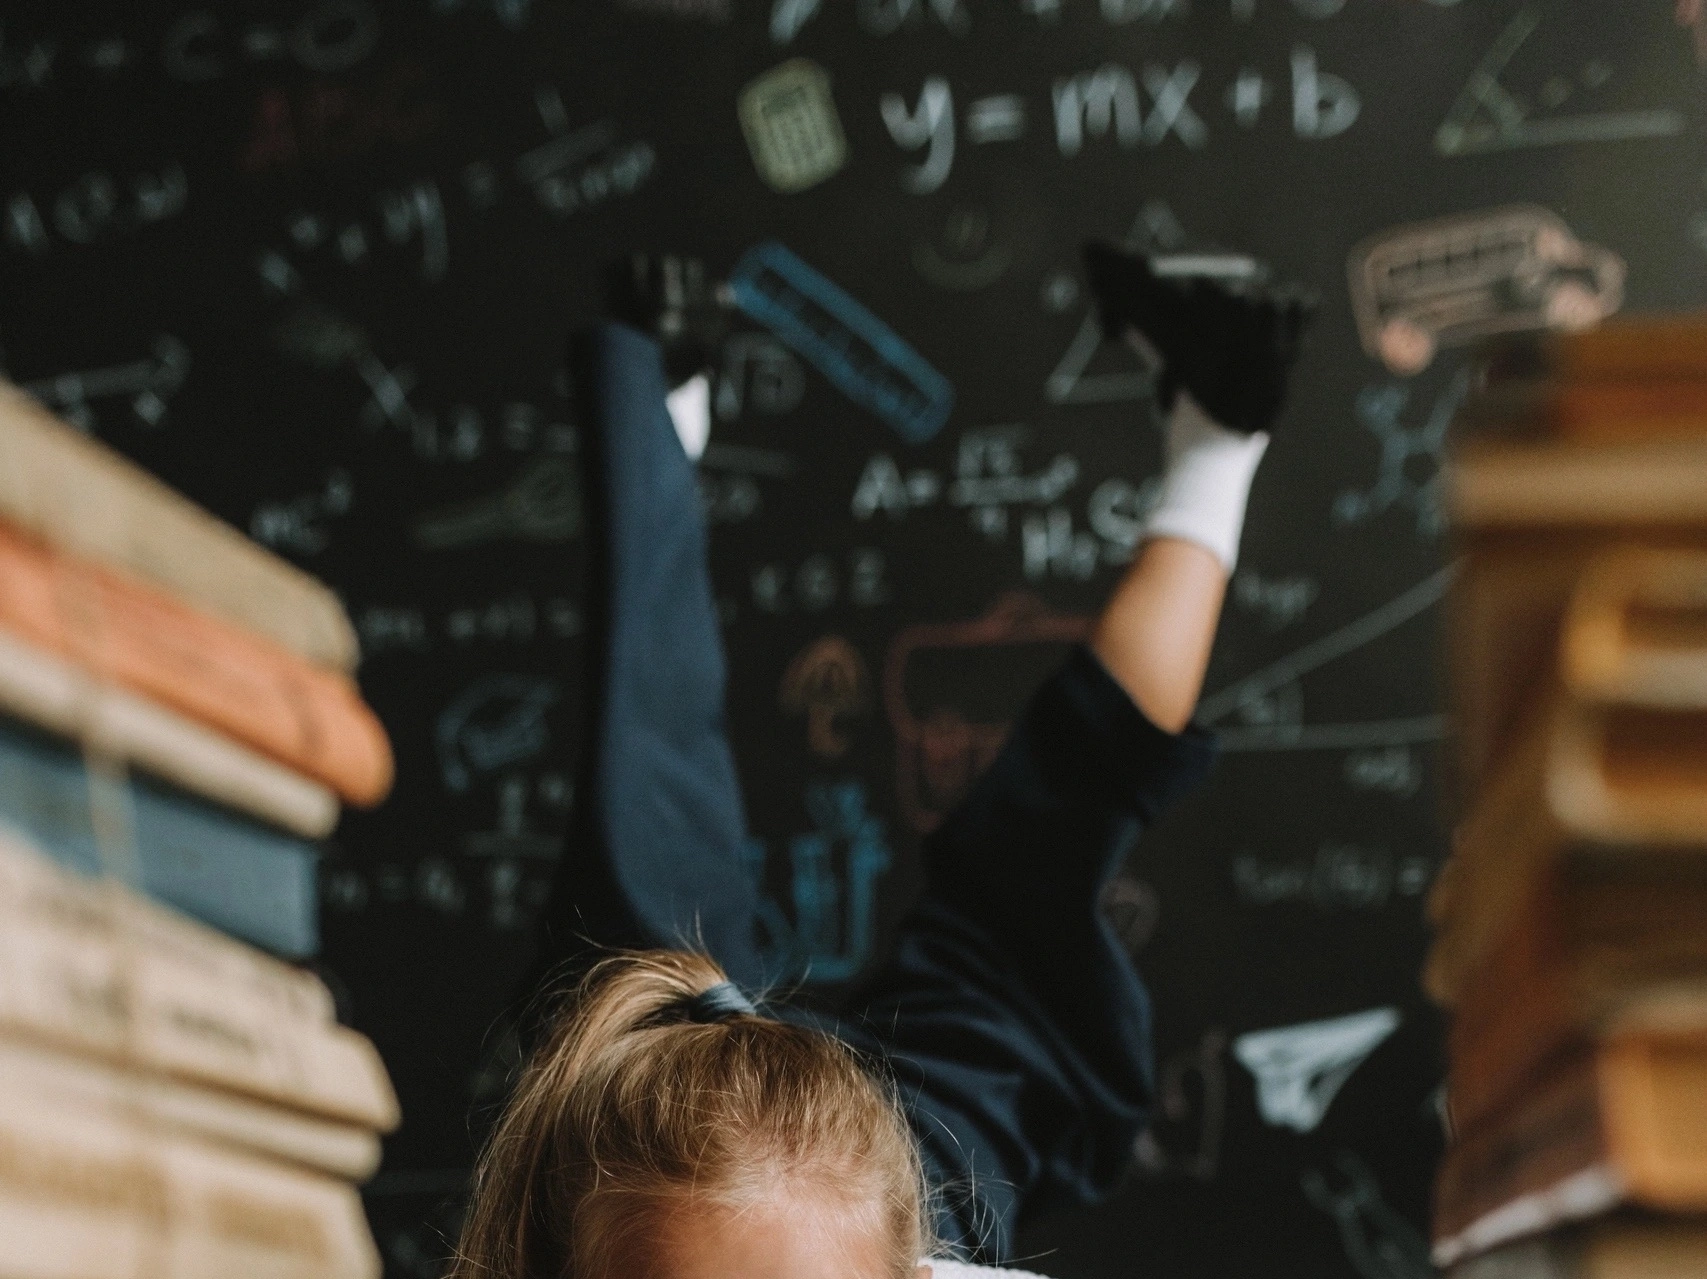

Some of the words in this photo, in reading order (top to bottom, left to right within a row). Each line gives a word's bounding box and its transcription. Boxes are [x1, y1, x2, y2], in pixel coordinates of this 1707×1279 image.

[880, 74, 956, 195] y
[1052, 60, 1208, 158] mx
[1290, 40, 1362, 140] b
